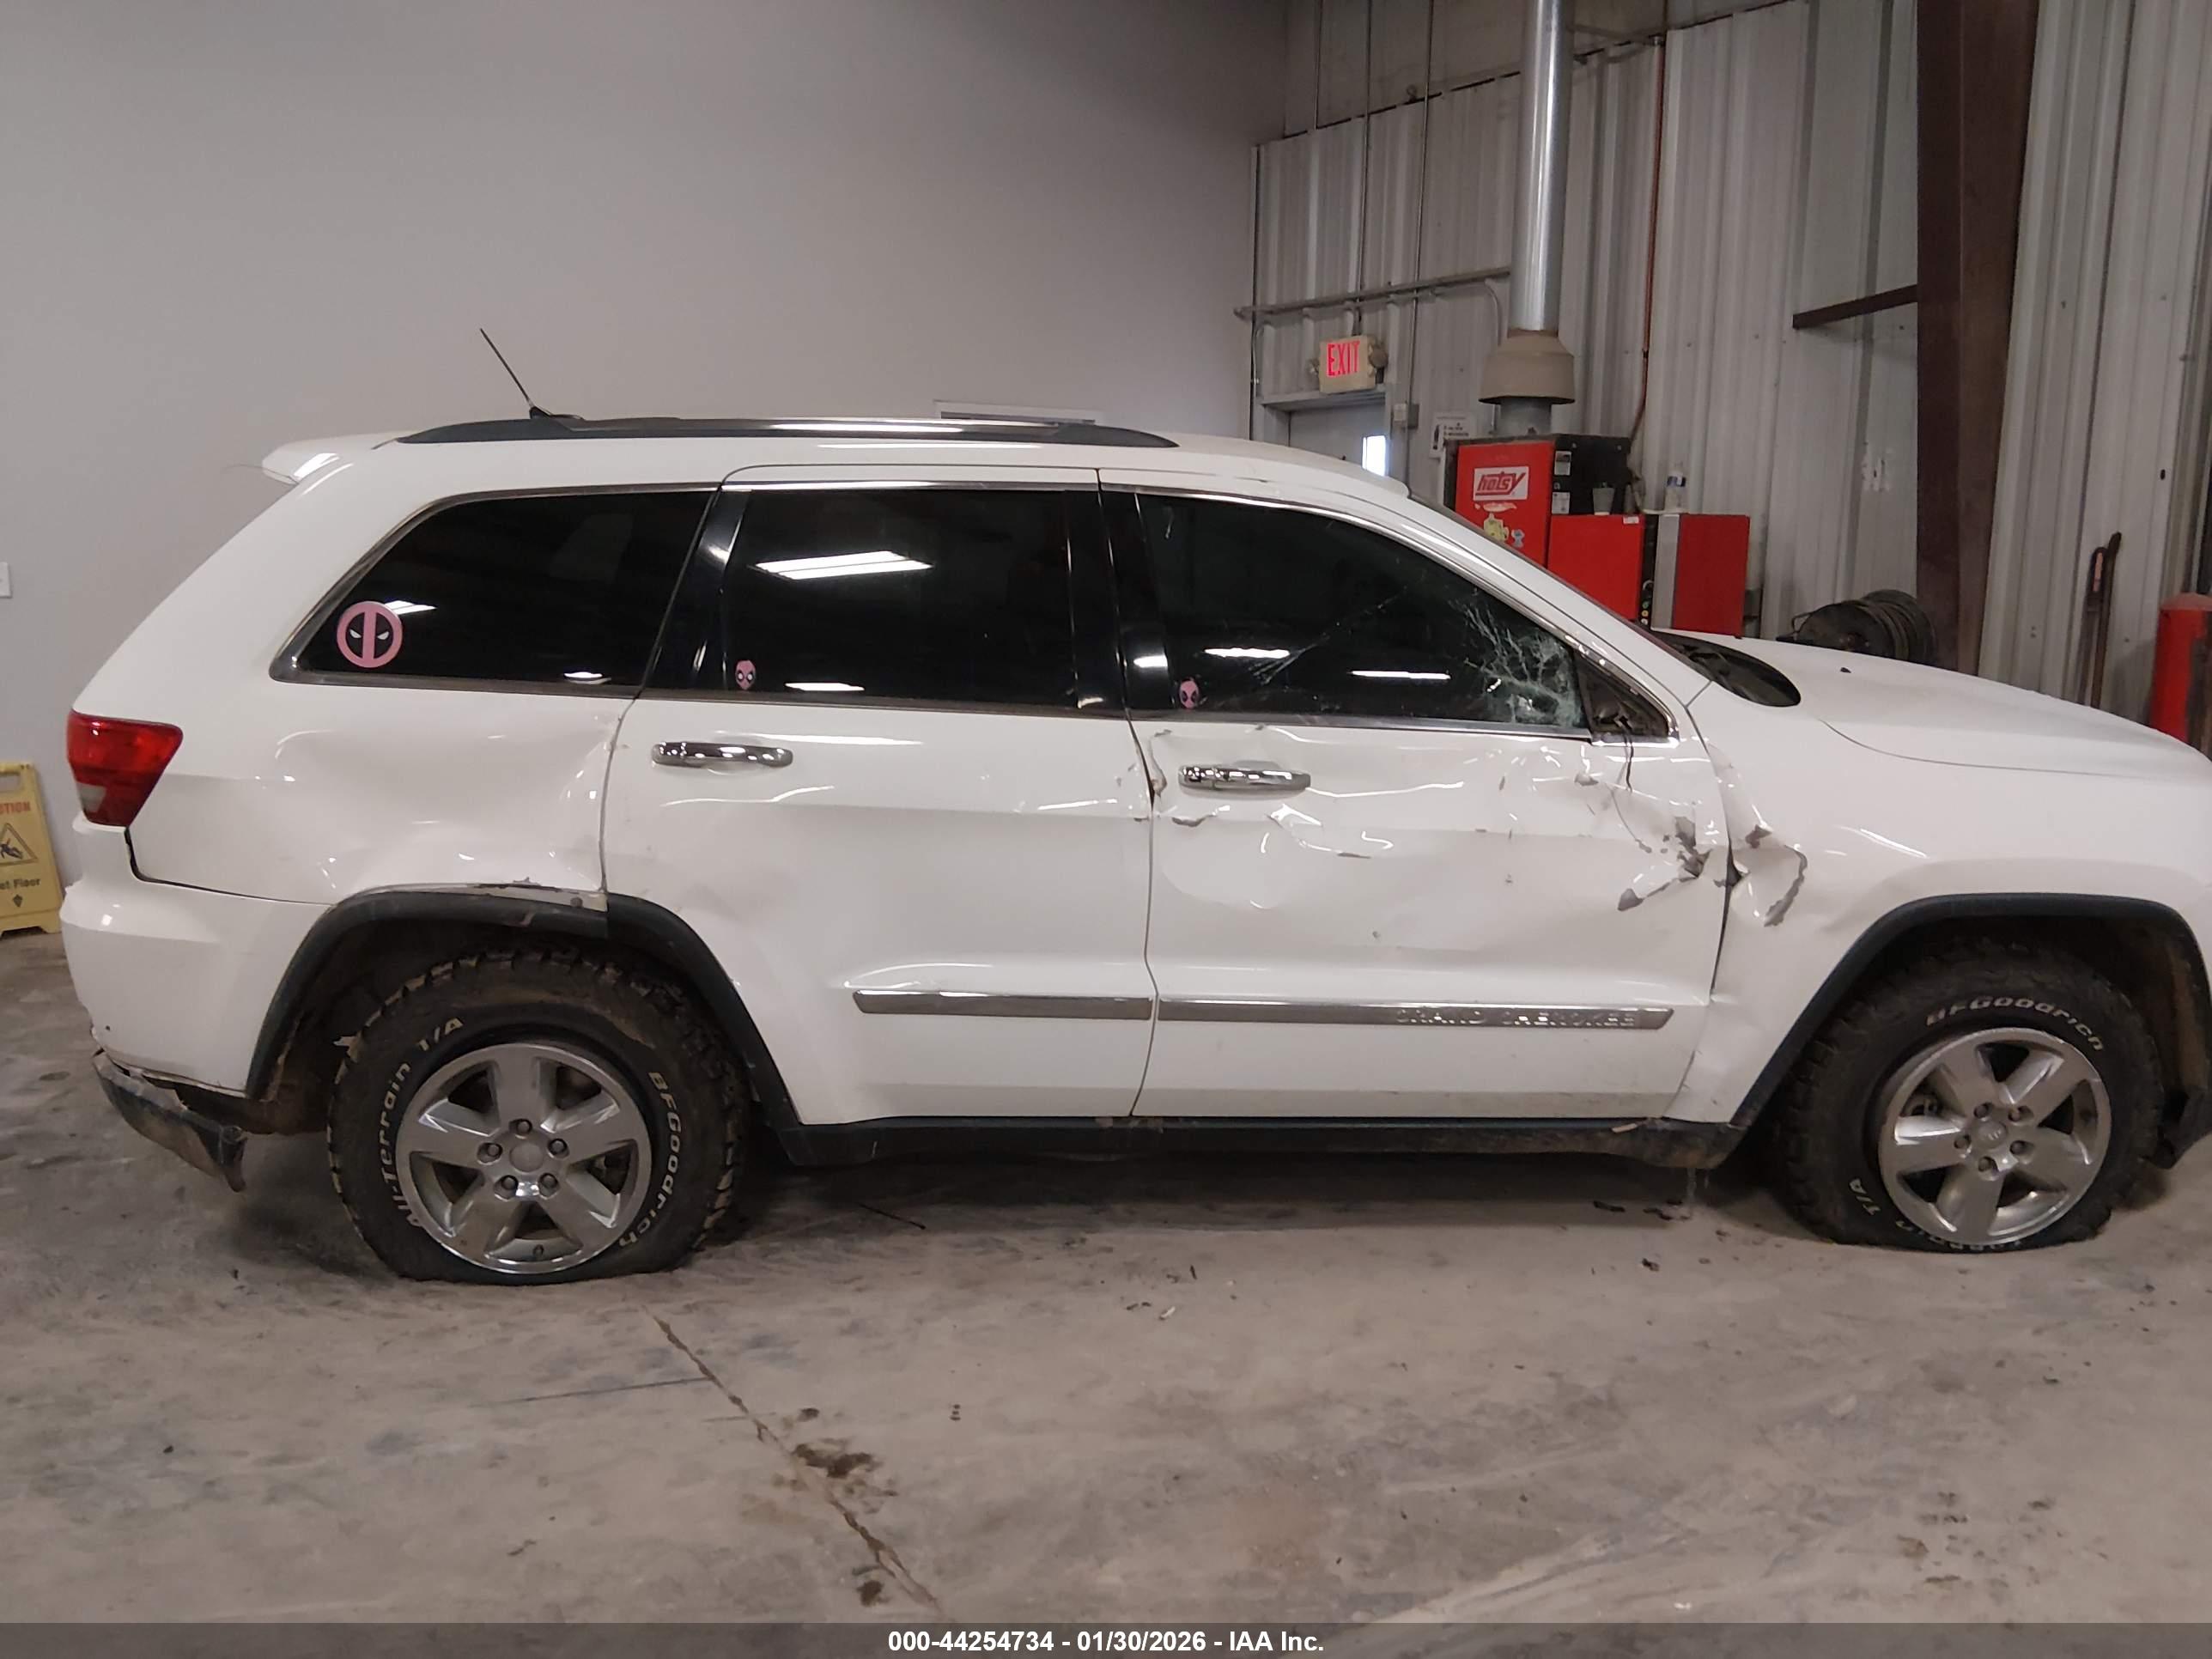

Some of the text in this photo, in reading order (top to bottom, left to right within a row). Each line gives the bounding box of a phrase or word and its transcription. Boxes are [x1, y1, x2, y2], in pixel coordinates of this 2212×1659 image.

[1327, 340, 1360, 376] EXIT
[0, 802, 31, 814] TION
[0, 878, 40, 890] et Floor
[619, 1072, 682, 1247] BFGoodrich
